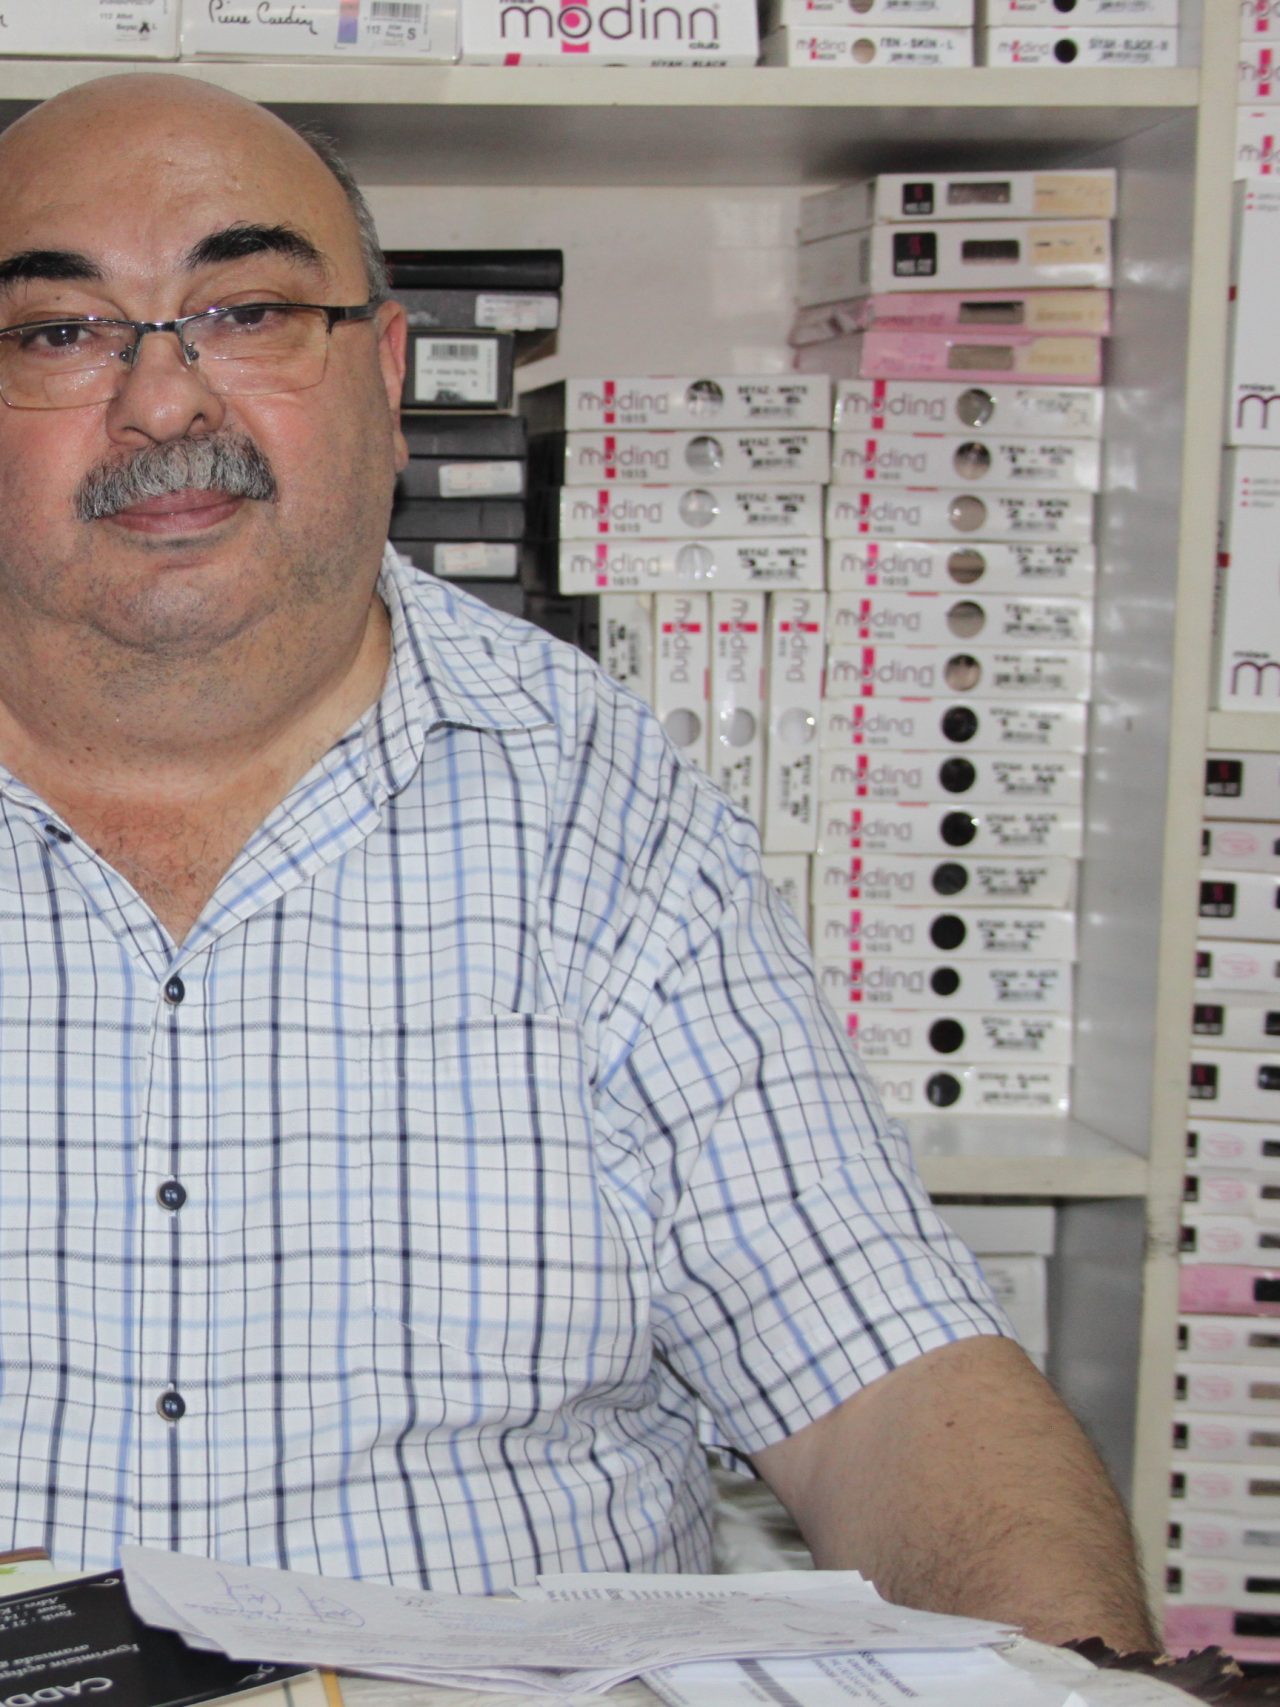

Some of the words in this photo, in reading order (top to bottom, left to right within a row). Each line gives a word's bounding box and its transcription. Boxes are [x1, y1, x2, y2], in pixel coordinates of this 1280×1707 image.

[500, 0, 719, 41] modinn
[24, 1596, 58, 1609] Adres
[42, 1609, 77, 1623] Tarih
